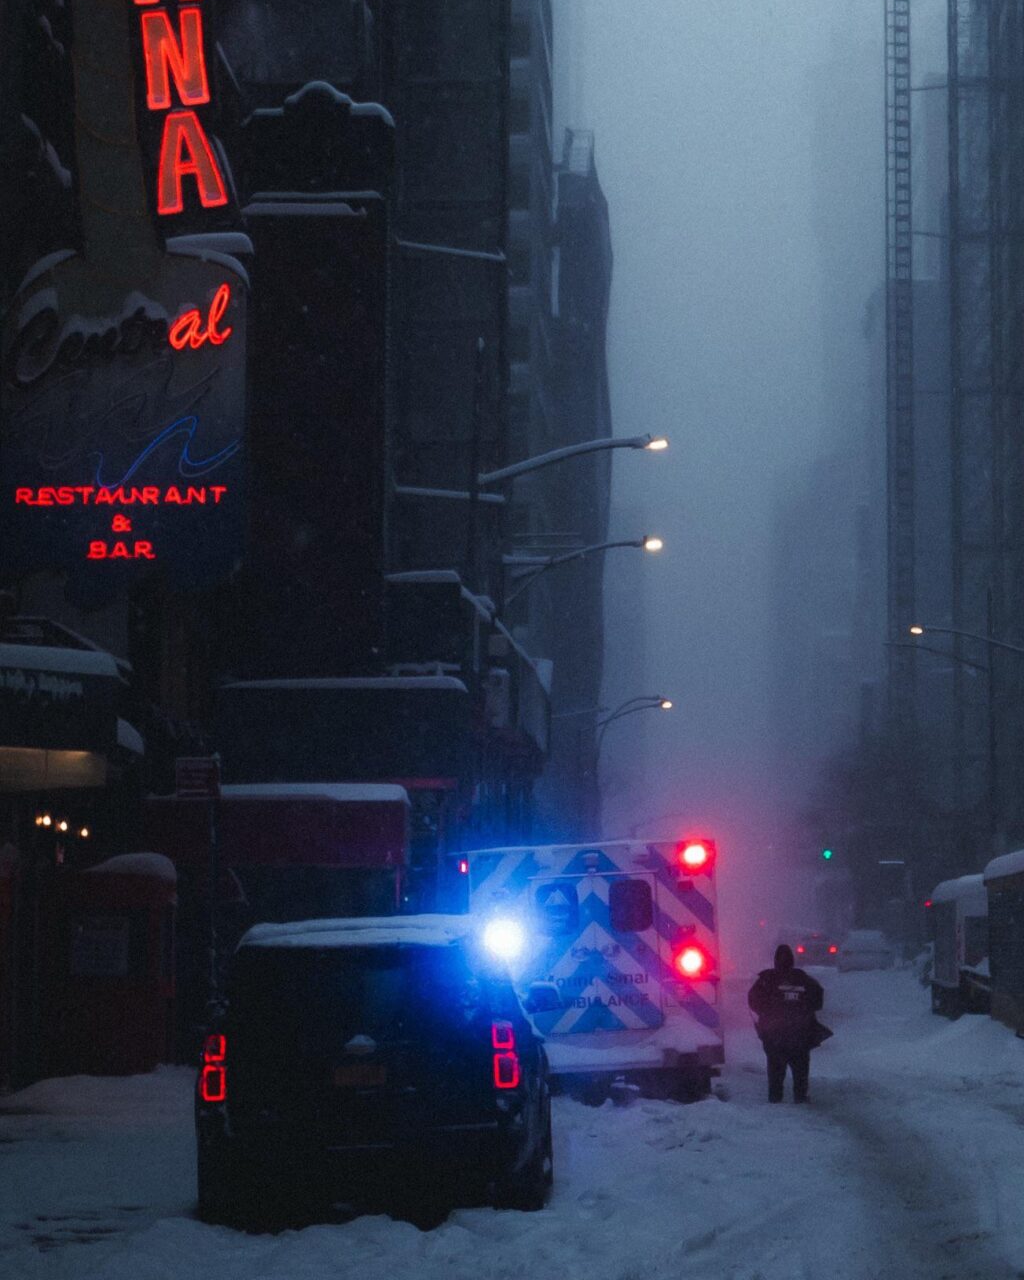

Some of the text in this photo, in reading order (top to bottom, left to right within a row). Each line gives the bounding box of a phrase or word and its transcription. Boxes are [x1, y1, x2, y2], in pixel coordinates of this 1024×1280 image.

[15, 485, 228, 506] RESTAURANT
[111, 514, 133, 534] &
[86, 541, 156, 560] BAR
